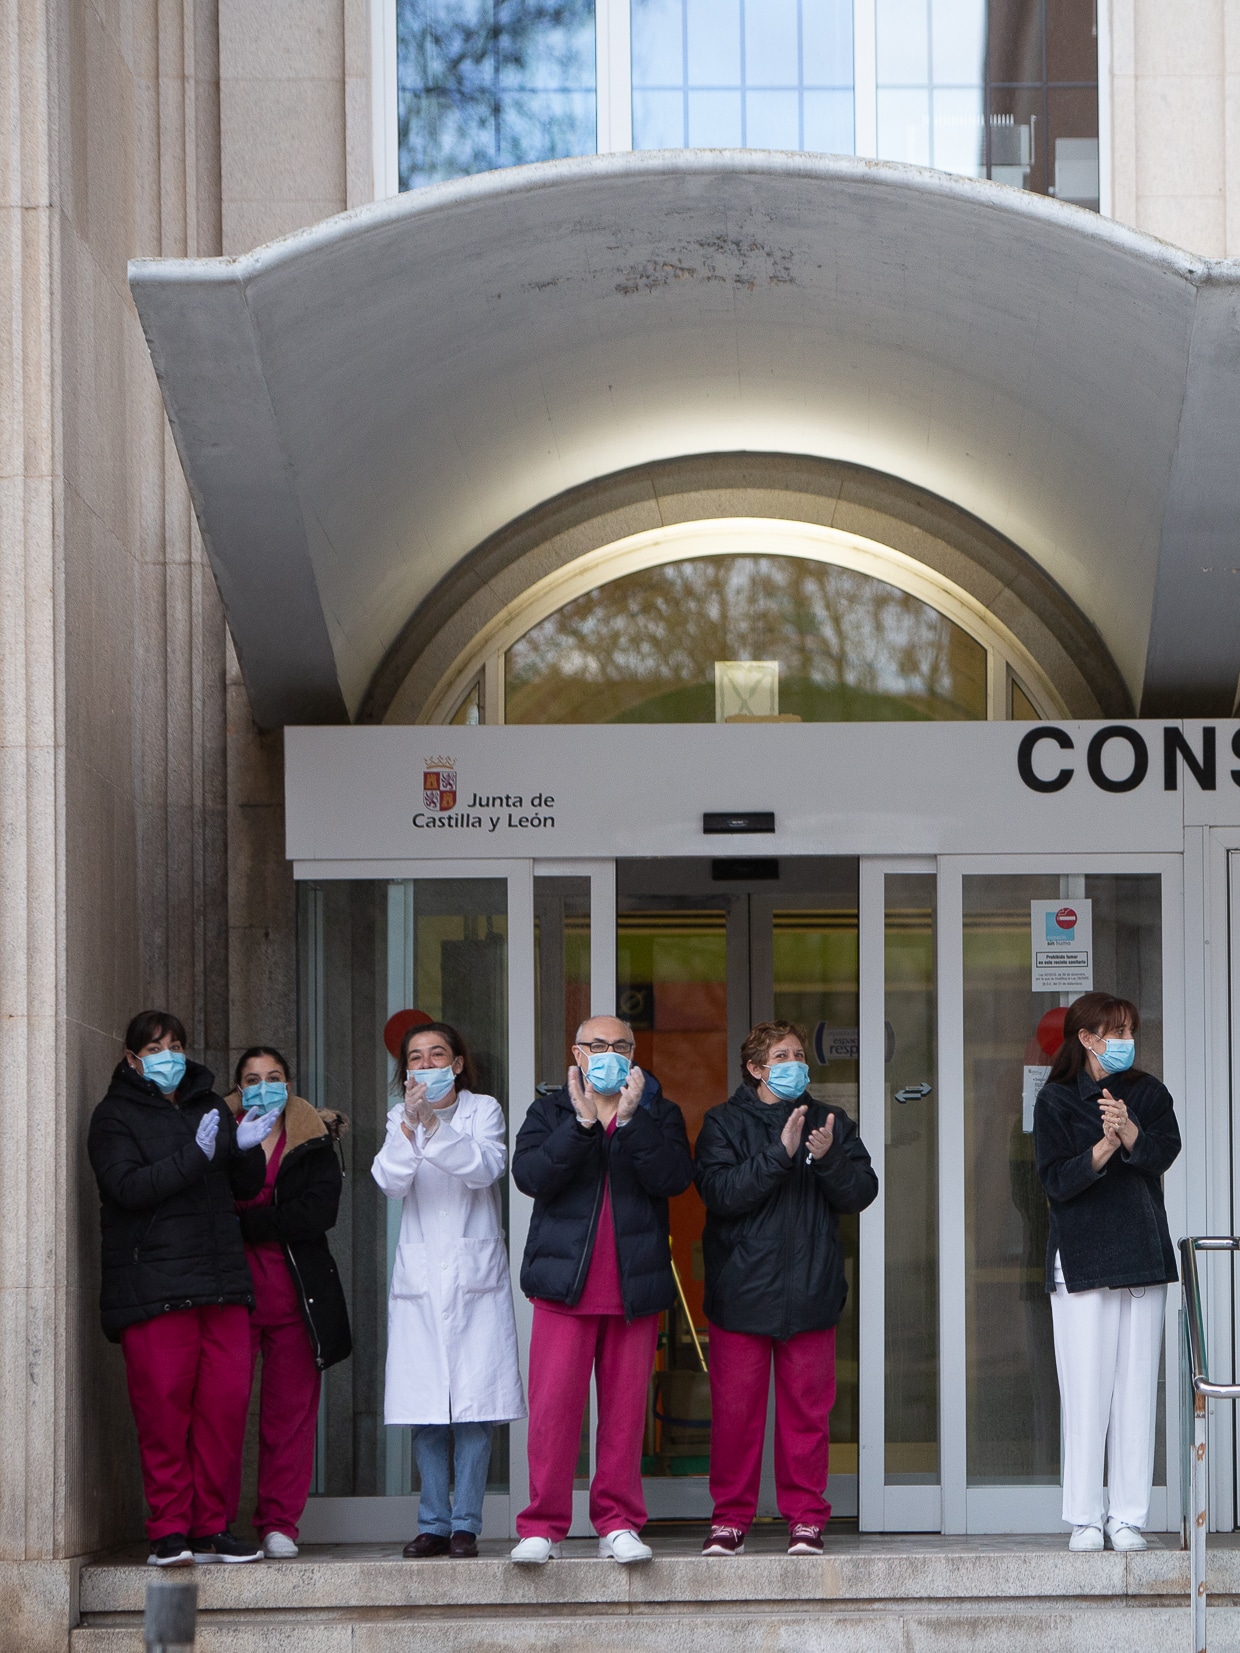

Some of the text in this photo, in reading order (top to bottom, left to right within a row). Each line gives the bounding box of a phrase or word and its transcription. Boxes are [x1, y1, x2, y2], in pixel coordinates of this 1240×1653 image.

[467, 793, 555, 808] Junta de
[412, 812, 555, 833] Castilla y León
